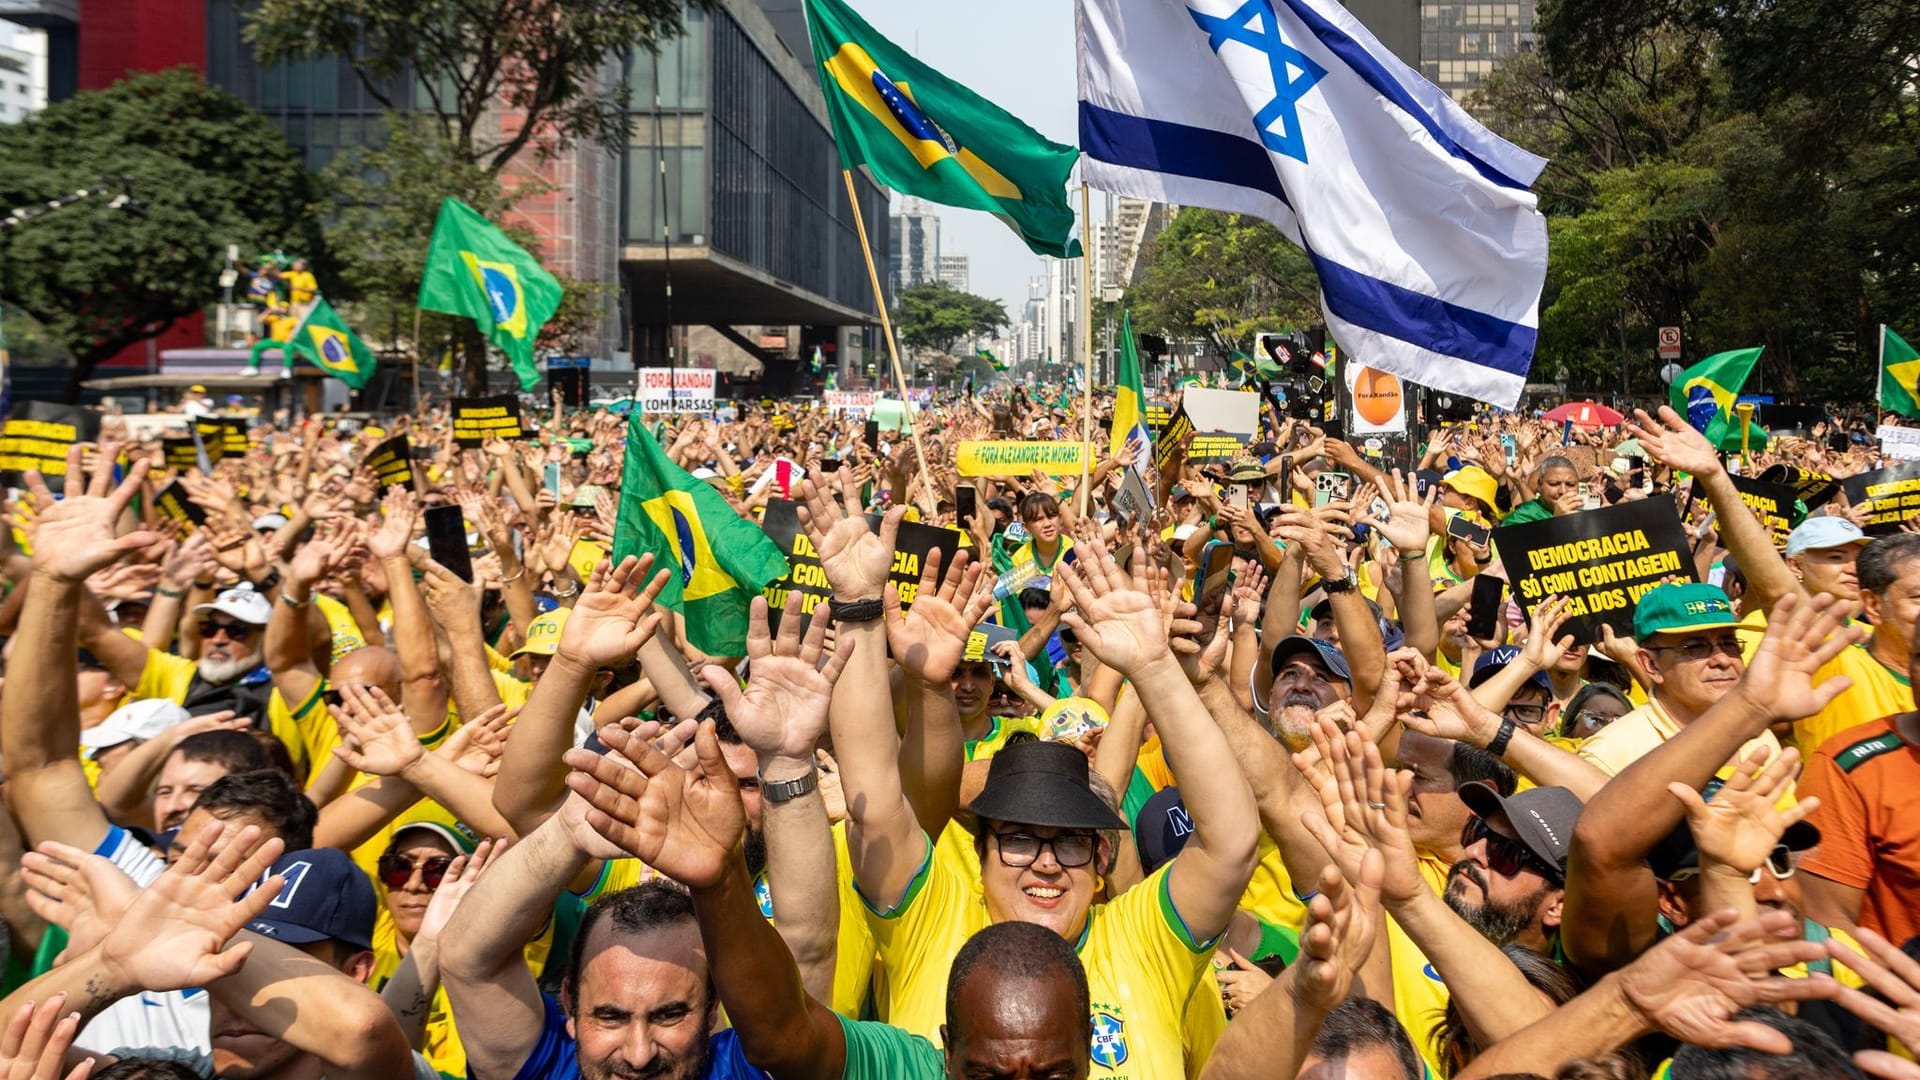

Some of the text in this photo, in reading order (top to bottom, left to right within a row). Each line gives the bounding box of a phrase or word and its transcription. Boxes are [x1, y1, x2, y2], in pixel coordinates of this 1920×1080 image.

[645, 373, 672, 388] FORA
[645, 400, 713, 411] COMPARSAS
[1001, 445, 1038, 464] ALEXANDRE
[1528, 529, 1650, 571] DEMOCRACIA
[1520, 551, 1681, 598] SÓ COM CONTAGEM
[1590, 588, 1627, 612] DOS
[1097, 1035, 1113, 1043] CBF
